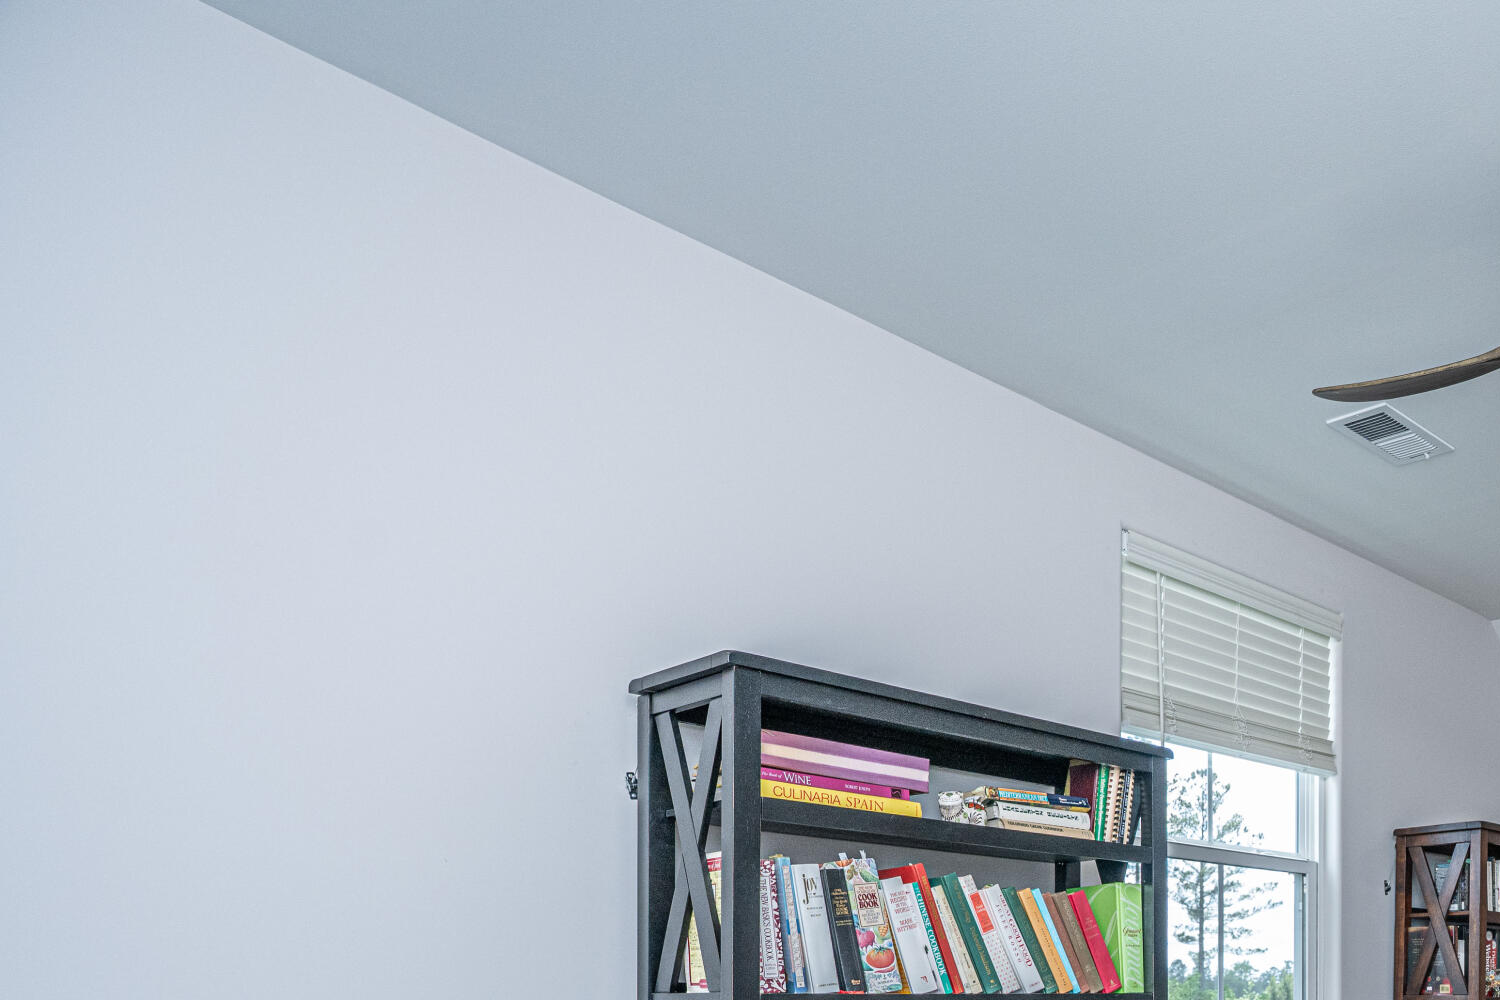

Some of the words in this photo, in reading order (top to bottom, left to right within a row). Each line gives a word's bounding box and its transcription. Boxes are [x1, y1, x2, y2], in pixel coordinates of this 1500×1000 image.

[783, 771, 812, 786] WINE
[773, 786, 841, 805] CULINARIA
[845, 797, 884, 812] SPAIN
[760, 880, 768, 892] THE
[762, 893, 770, 906] NEW
[857, 892, 879, 902] COOK
[859, 900, 881, 910] BOOK
[762, 907, 771, 927] BASICS
[916, 893, 933, 929] CHINESE
[926, 929, 948, 977] COOKBOOK
[764, 928, 774, 961] COOKBOOK
